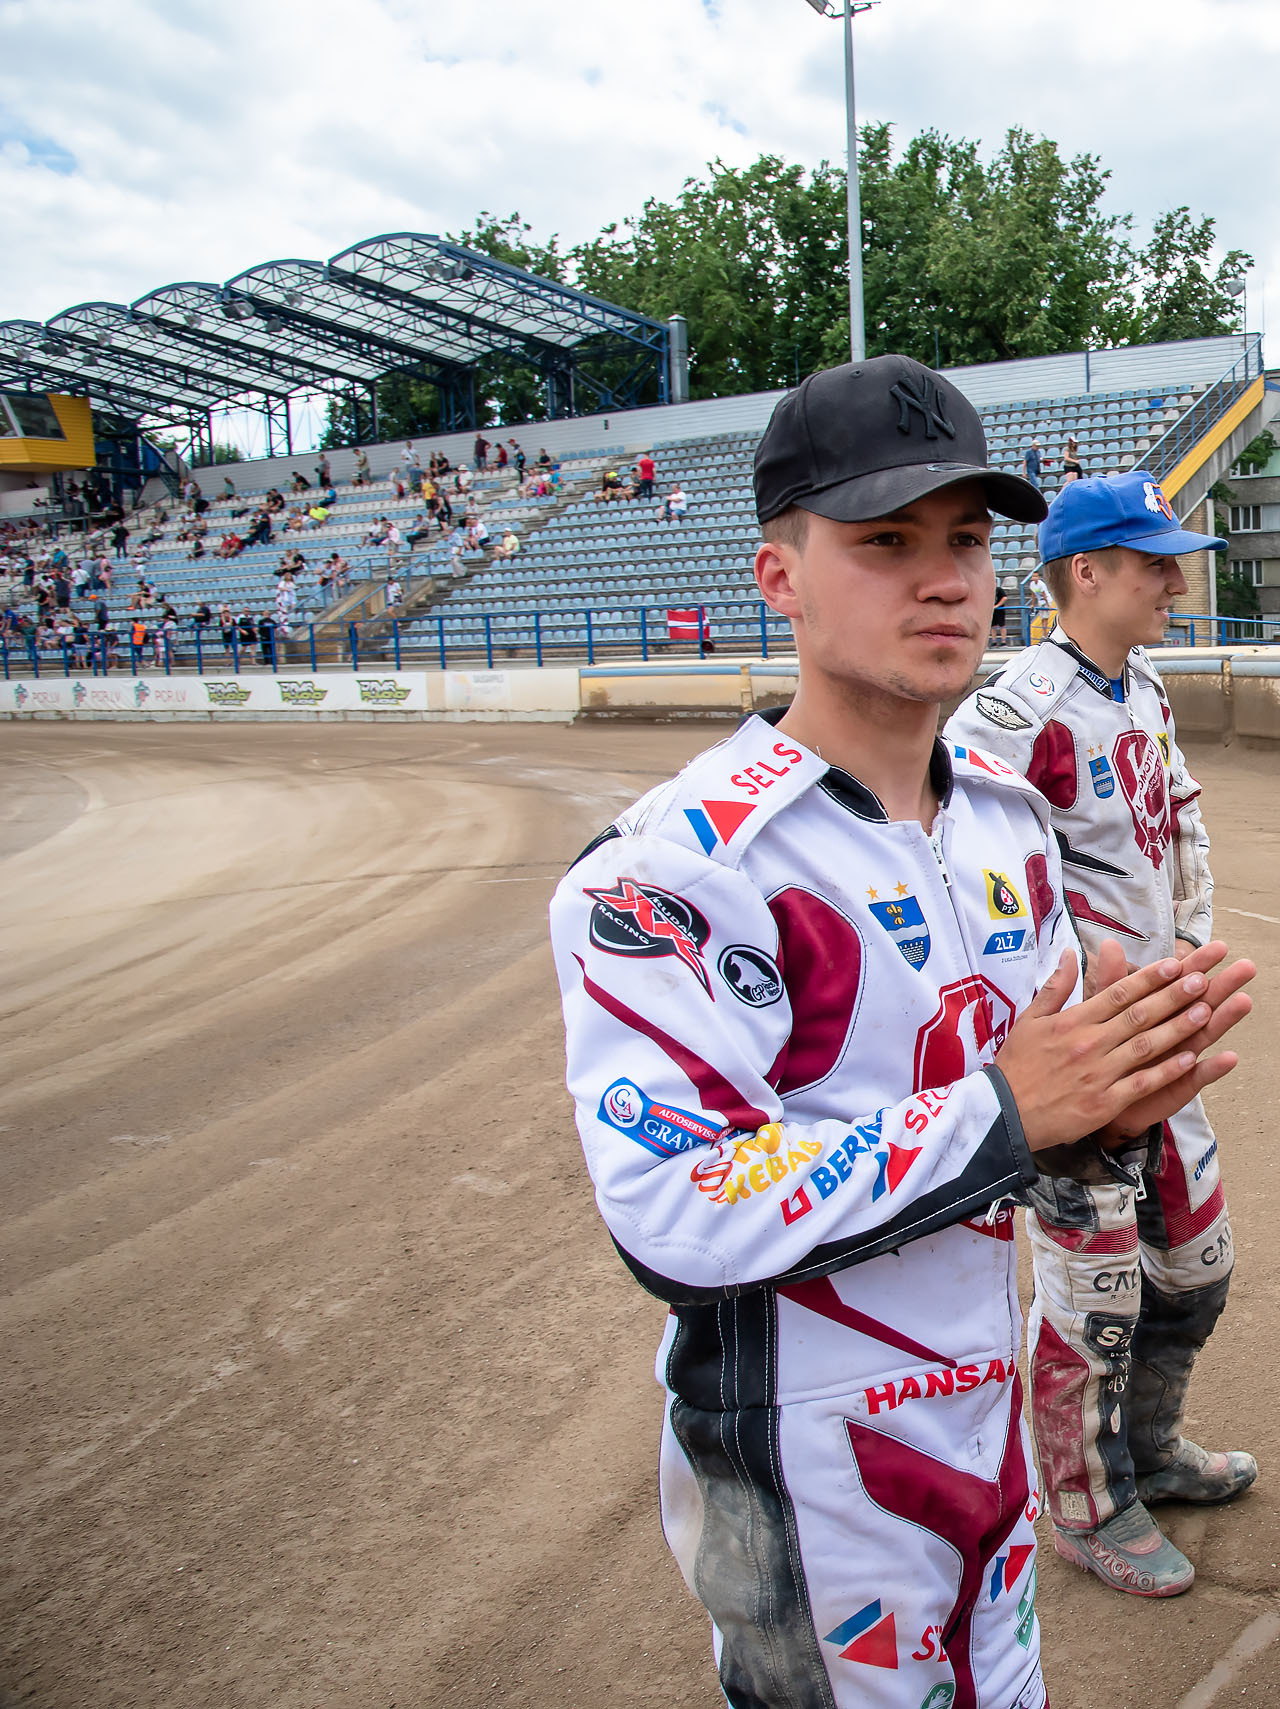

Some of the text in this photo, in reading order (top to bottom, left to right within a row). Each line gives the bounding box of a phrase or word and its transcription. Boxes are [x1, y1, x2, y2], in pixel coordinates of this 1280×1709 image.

[730, 742, 802, 795] SELS
[598, 903, 650, 945] RACING
[658, 1108, 718, 1141] AUTOSERVISS
